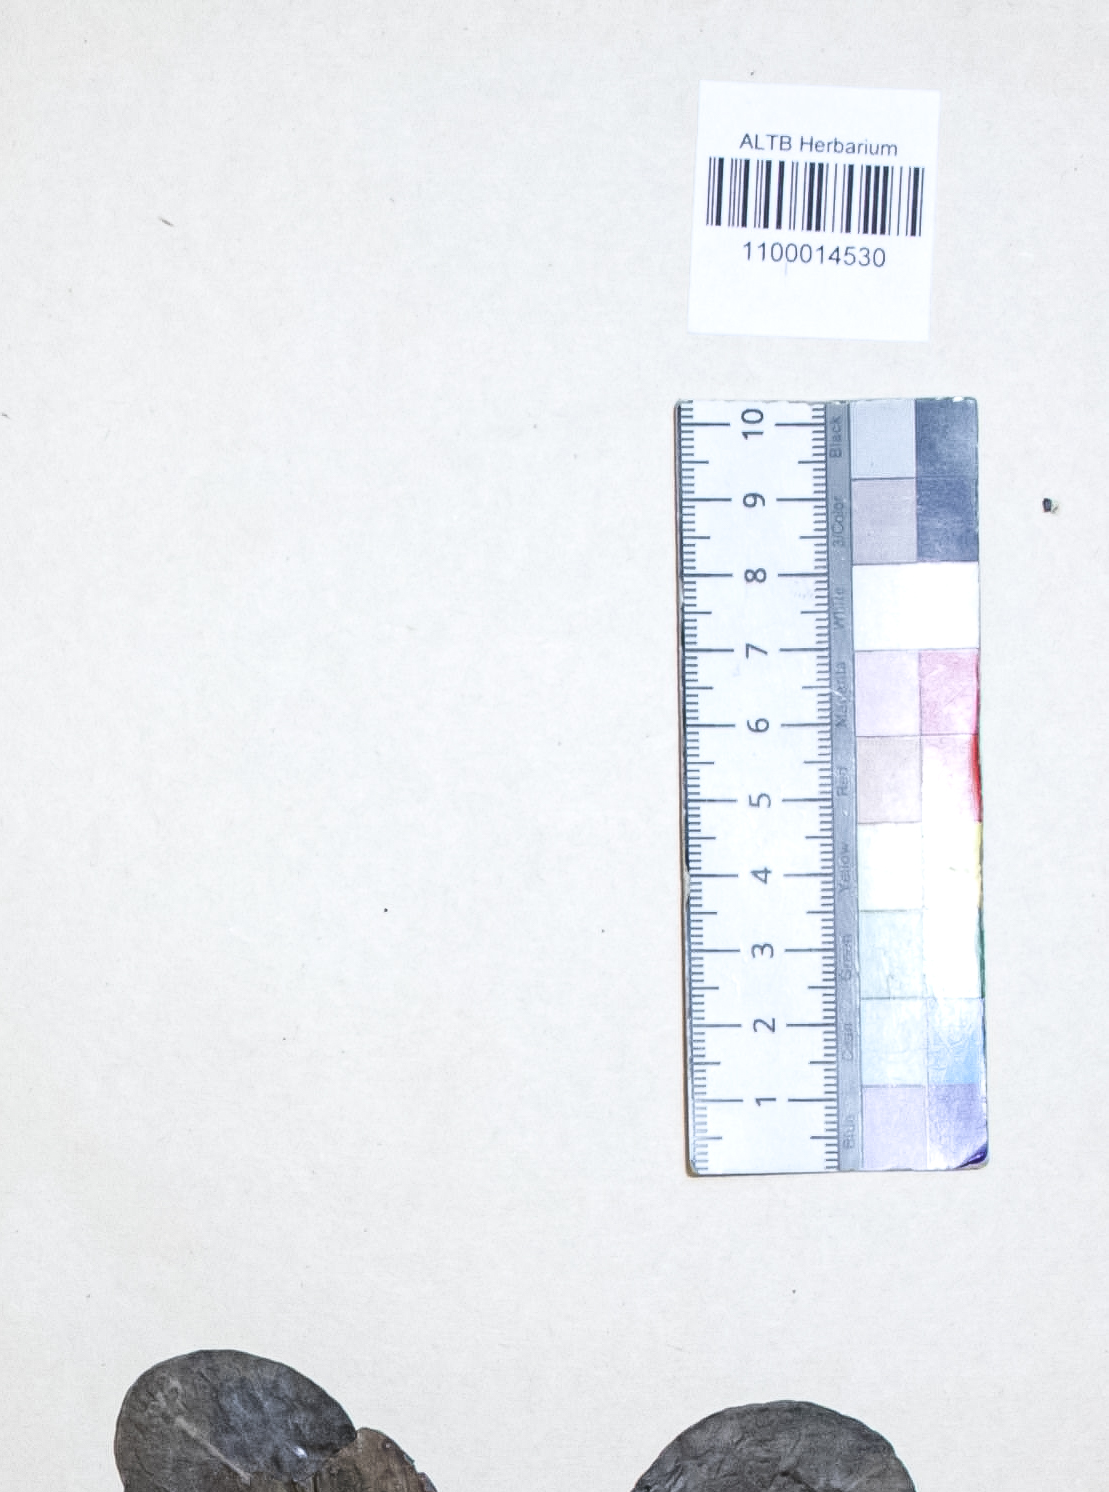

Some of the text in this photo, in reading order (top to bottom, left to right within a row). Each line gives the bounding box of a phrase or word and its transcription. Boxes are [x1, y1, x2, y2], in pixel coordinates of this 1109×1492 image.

[739, 133, 898, 157] ALTB Herbarium
[742, 241, 887, 269] 1100014530
[741, 407, 765, 441] 10
[830, 415, 844, 458] Black
[743, 492, 767, 509] 9
[832, 494, 846, 548] 3/Color
[745, 566, 768, 584] 8
[745, 643, 769, 659] 7
[747, 717, 771, 734] 6
[748, 792, 772, 808] 5
[751, 866, 772, 885] 4
[837, 843, 852, 895] Yellow
[751, 942, 775, 959] 3
[752, 1017, 777, 1034] 2
[755, 1096, 777, 1107] 1
